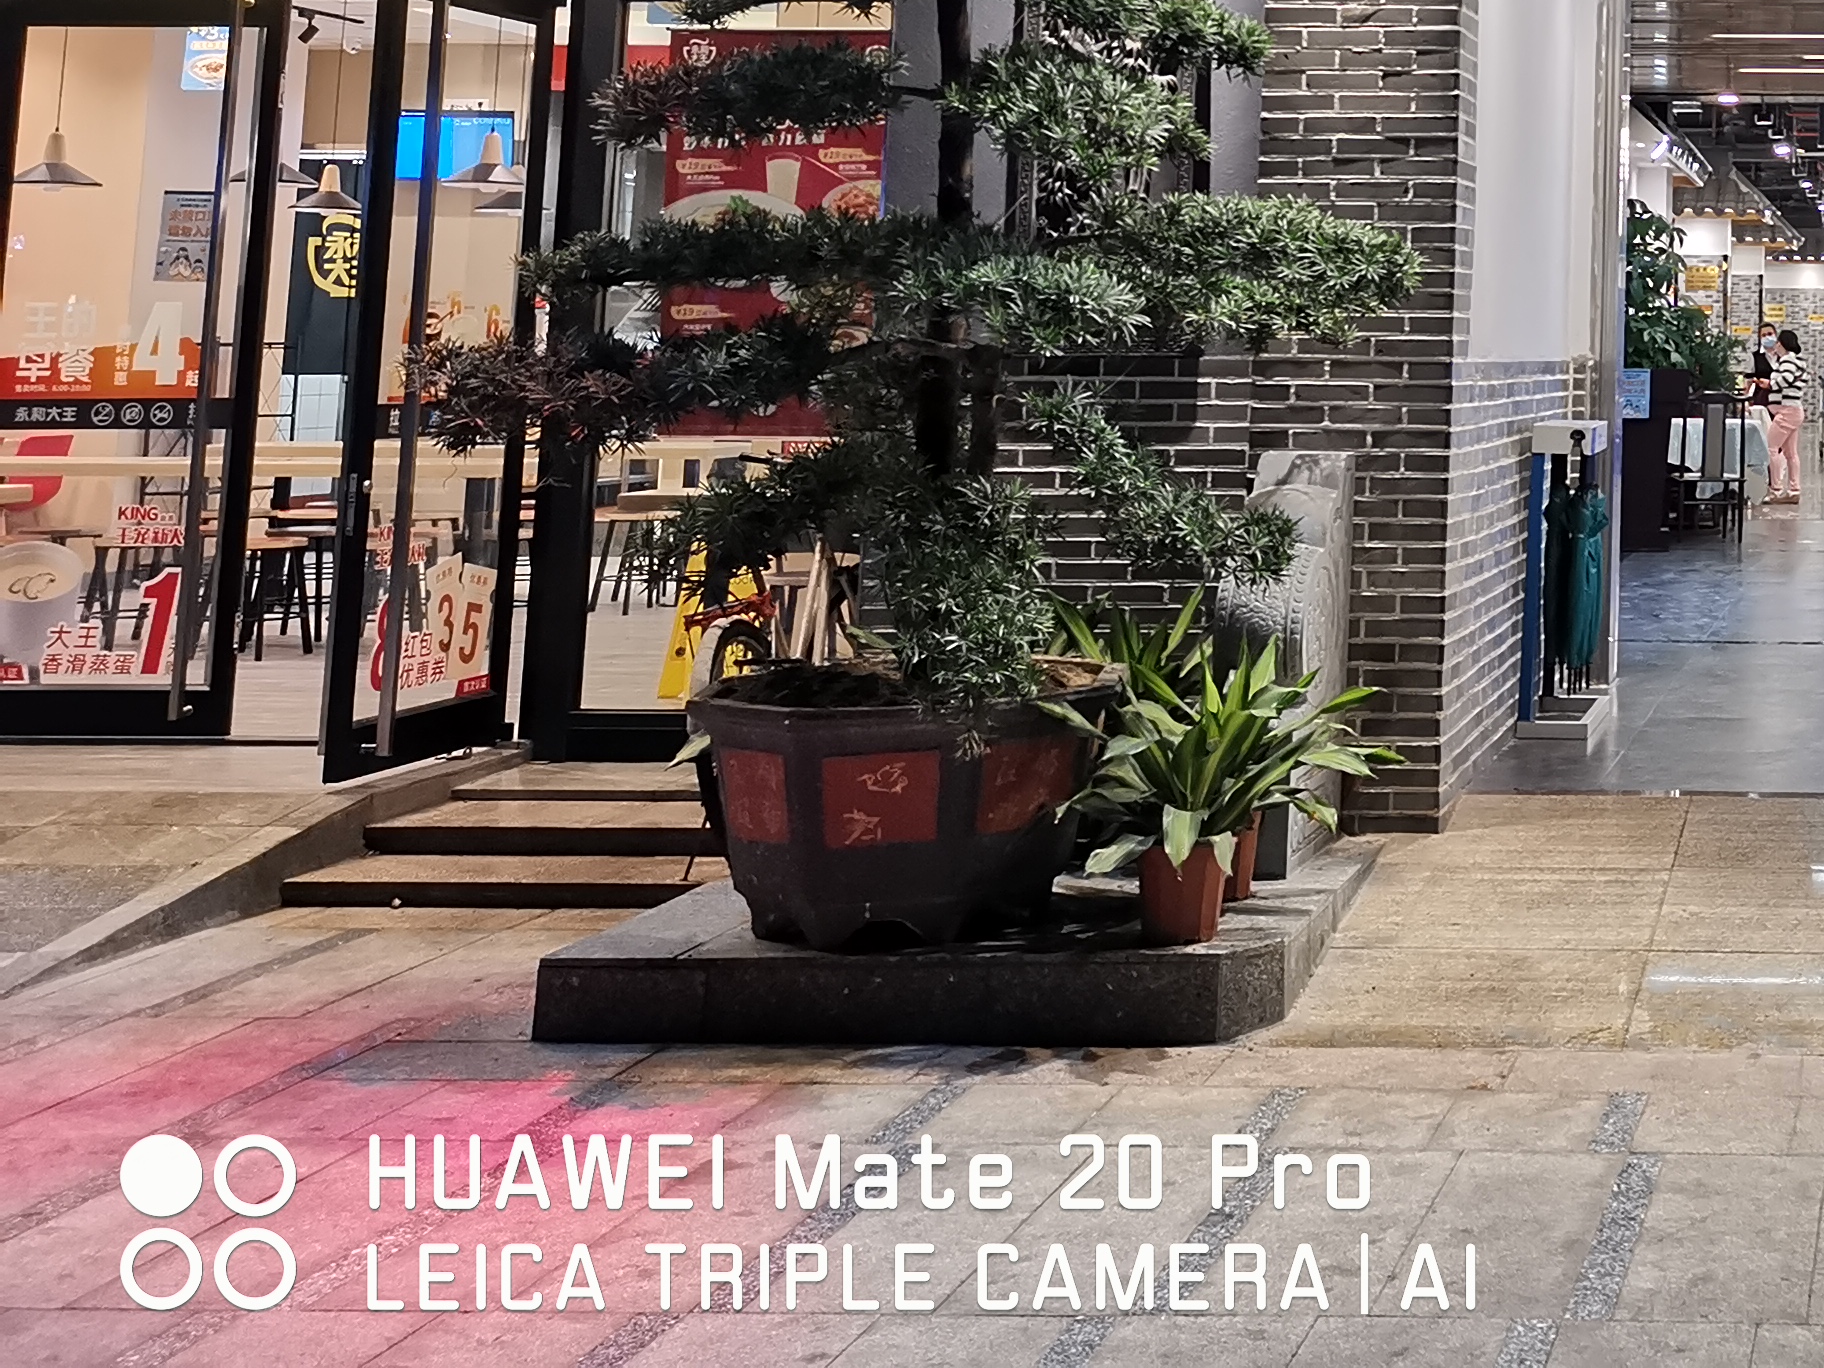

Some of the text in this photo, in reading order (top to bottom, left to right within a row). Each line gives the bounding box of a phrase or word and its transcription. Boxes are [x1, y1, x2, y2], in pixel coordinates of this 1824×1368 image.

[132, 301, 184, 386] 4
[16, 342, 95, 383] 早餐
[14, 406, 77, 422] 永和大王
[117, 506, 158, 521] KING
[46, 625, 100, 649] 大王
[140, 568, 182, 676] 1
[438, 593, 455, 653] 3
[458, 601, 483, 665] 5
[401, 632, 433, 660] 红包
[42, 653, 135, 675] 香滑蒸蛋
[398, 656, 446, 691] 优惠券
